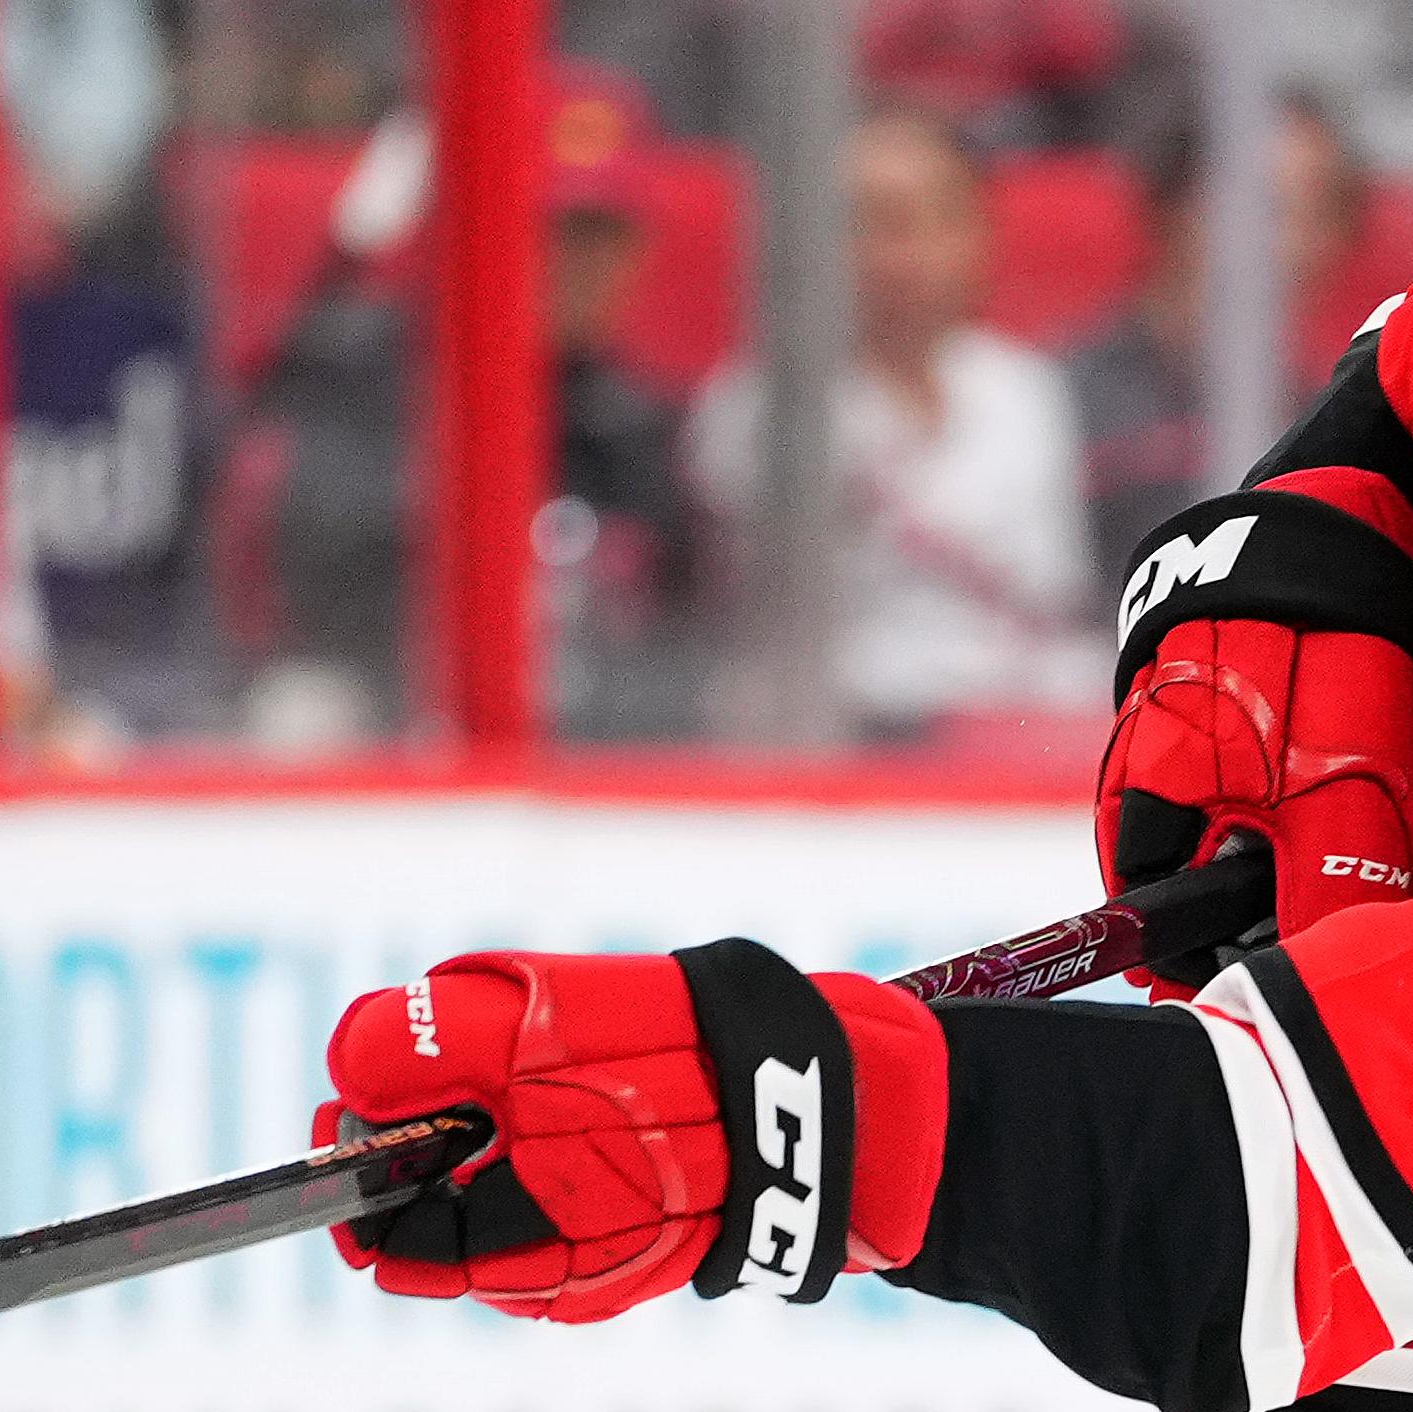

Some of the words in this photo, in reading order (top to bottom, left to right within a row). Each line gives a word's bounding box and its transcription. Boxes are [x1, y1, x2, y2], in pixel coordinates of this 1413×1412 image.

[1117, 515, 1260, 652] CM
[1321, 855, 1412, 889] CCM
[992, 948, 1098, 1001] BAUER
